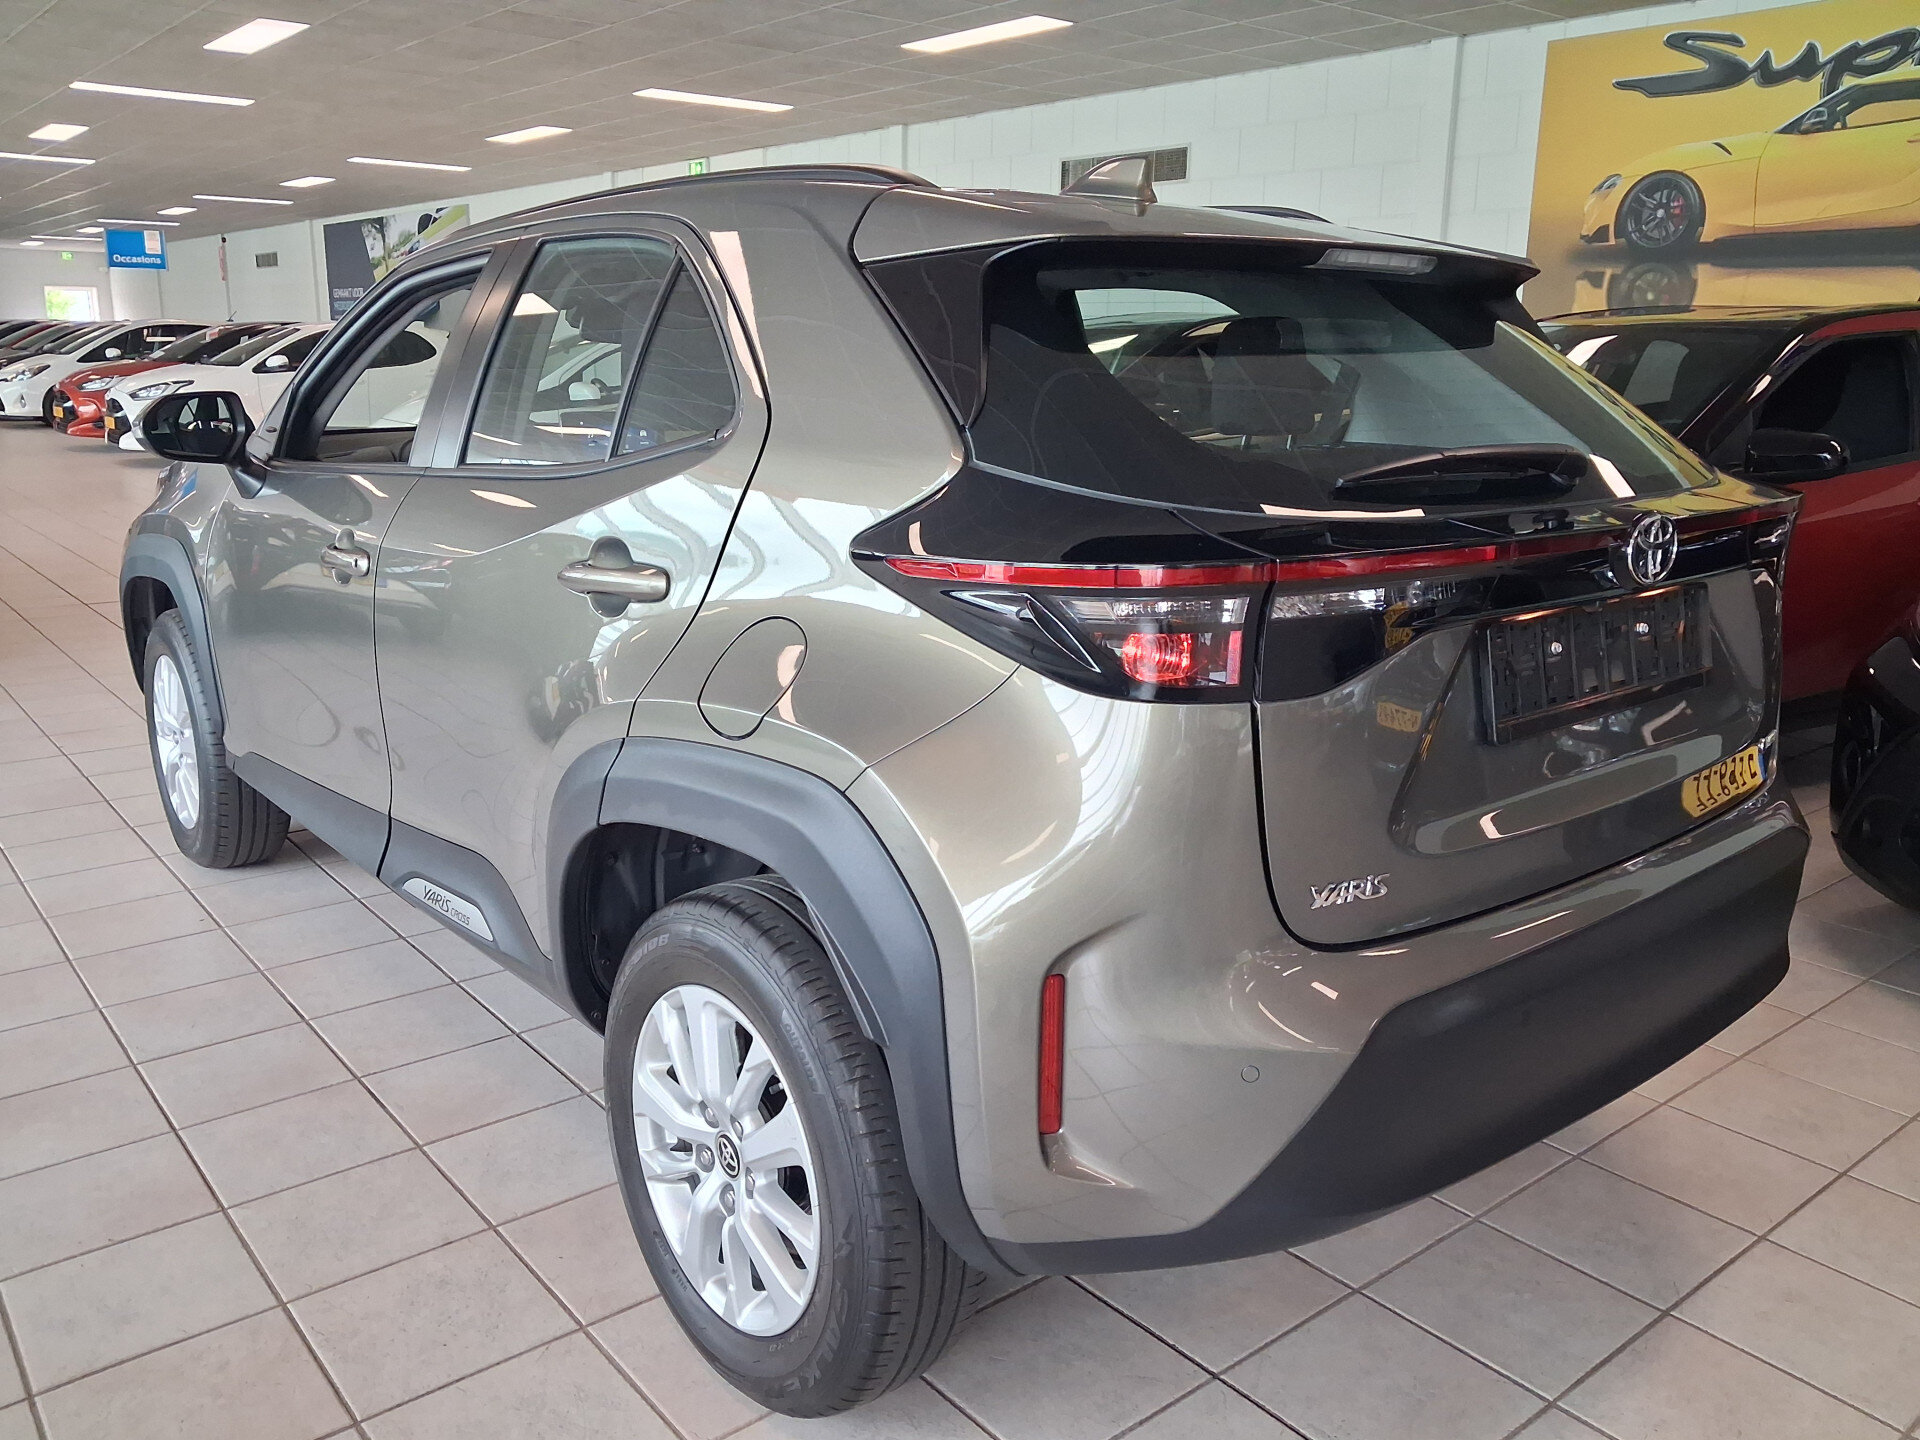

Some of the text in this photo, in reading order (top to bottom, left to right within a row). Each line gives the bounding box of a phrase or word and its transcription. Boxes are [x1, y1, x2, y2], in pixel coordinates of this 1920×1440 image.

[1612, 26, 1920, 99] Sup
[113, 254, 162, 264] Occasions
[450, 907, 471, 926] CROSS
